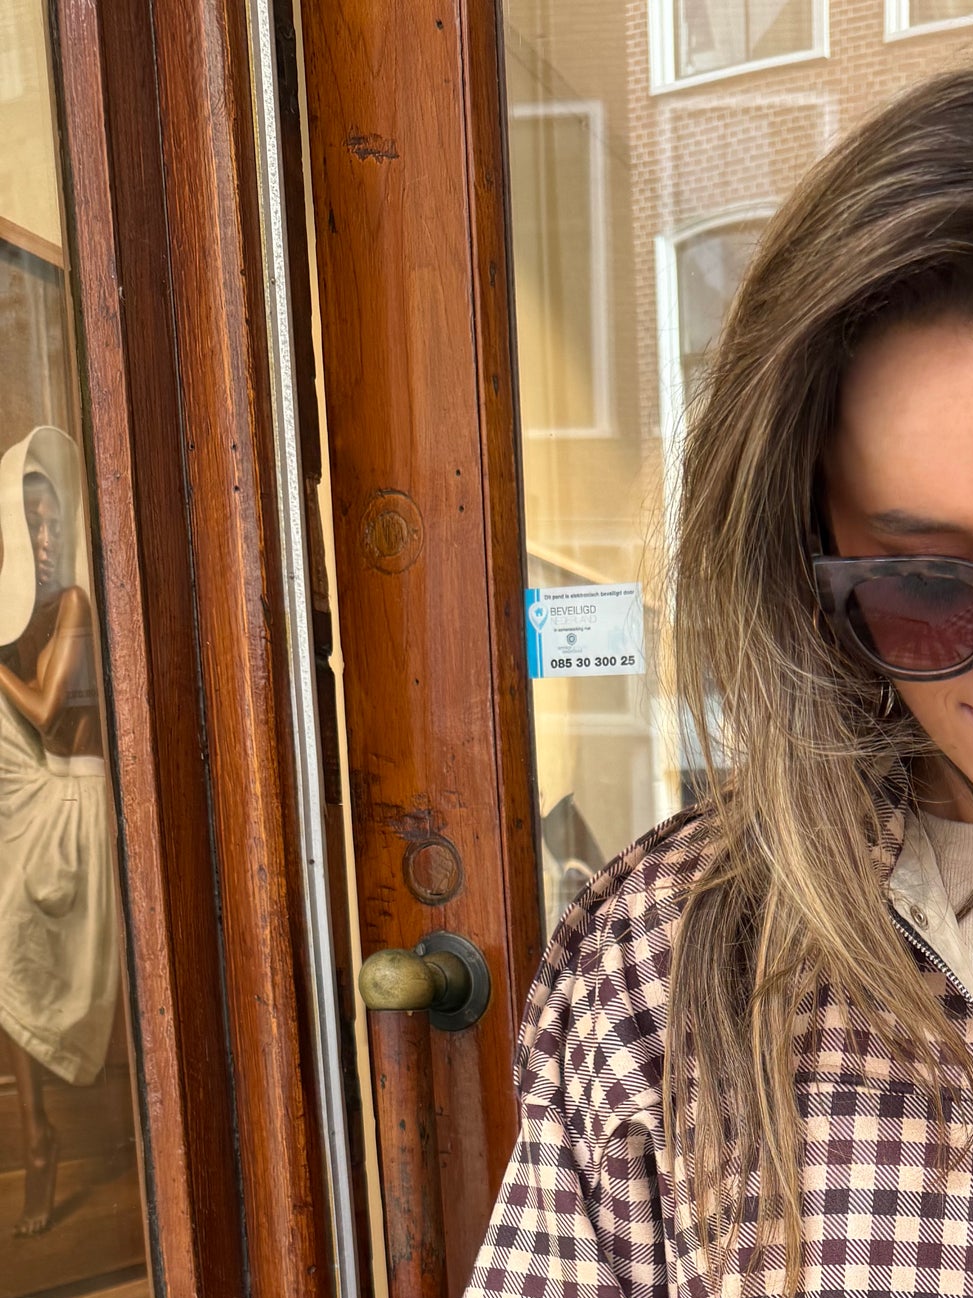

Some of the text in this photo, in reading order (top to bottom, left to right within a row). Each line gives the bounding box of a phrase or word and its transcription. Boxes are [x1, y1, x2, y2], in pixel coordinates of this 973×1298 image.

[550, 605, 597, 616] BEVEILIGD
[551, 655, 635, 669] 085 30 300 25
